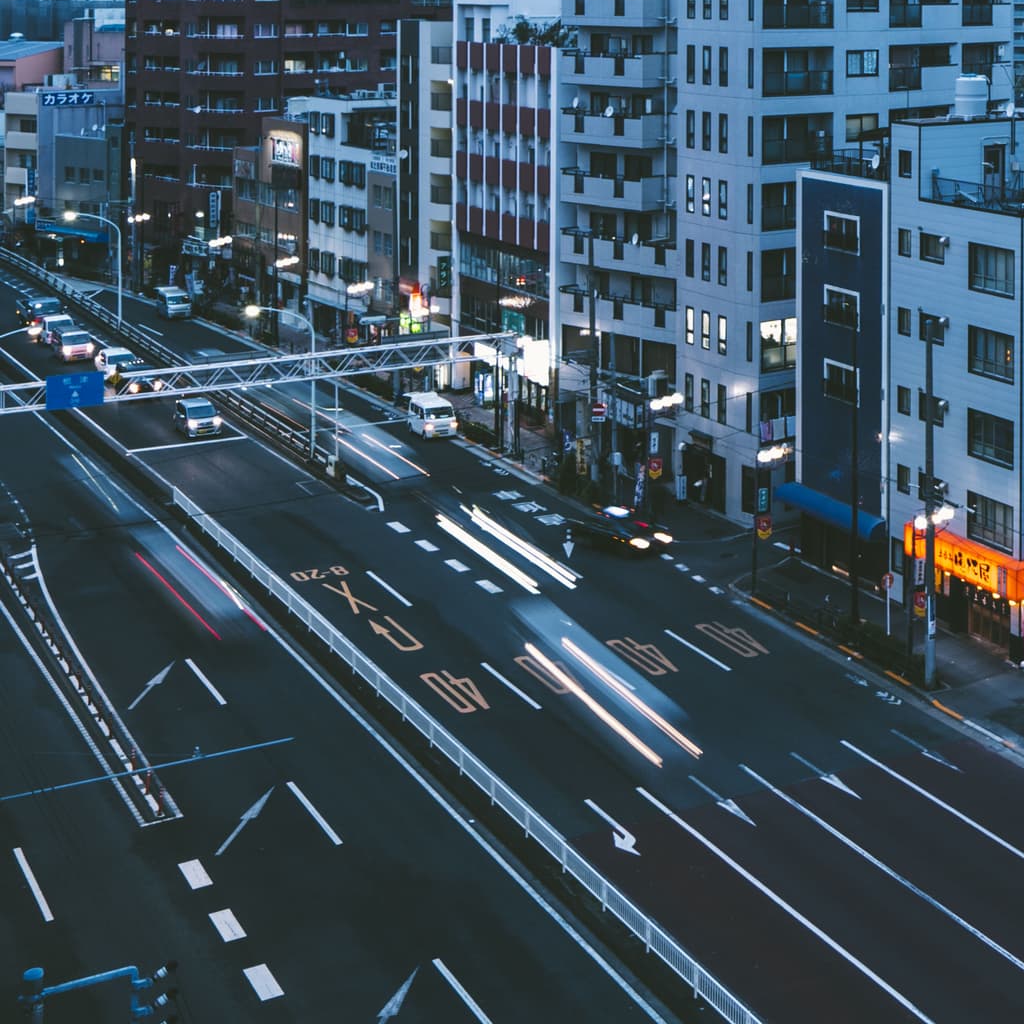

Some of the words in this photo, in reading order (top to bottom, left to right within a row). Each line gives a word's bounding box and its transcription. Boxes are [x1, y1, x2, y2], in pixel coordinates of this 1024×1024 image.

[44, 93, 93, 105] カラオケ
[290, 565, 350, 583] 8-20
[606, 636, 680, 676] 40
[694, 620, 771, 658] 40
[419, 670, 491, 714] 40
